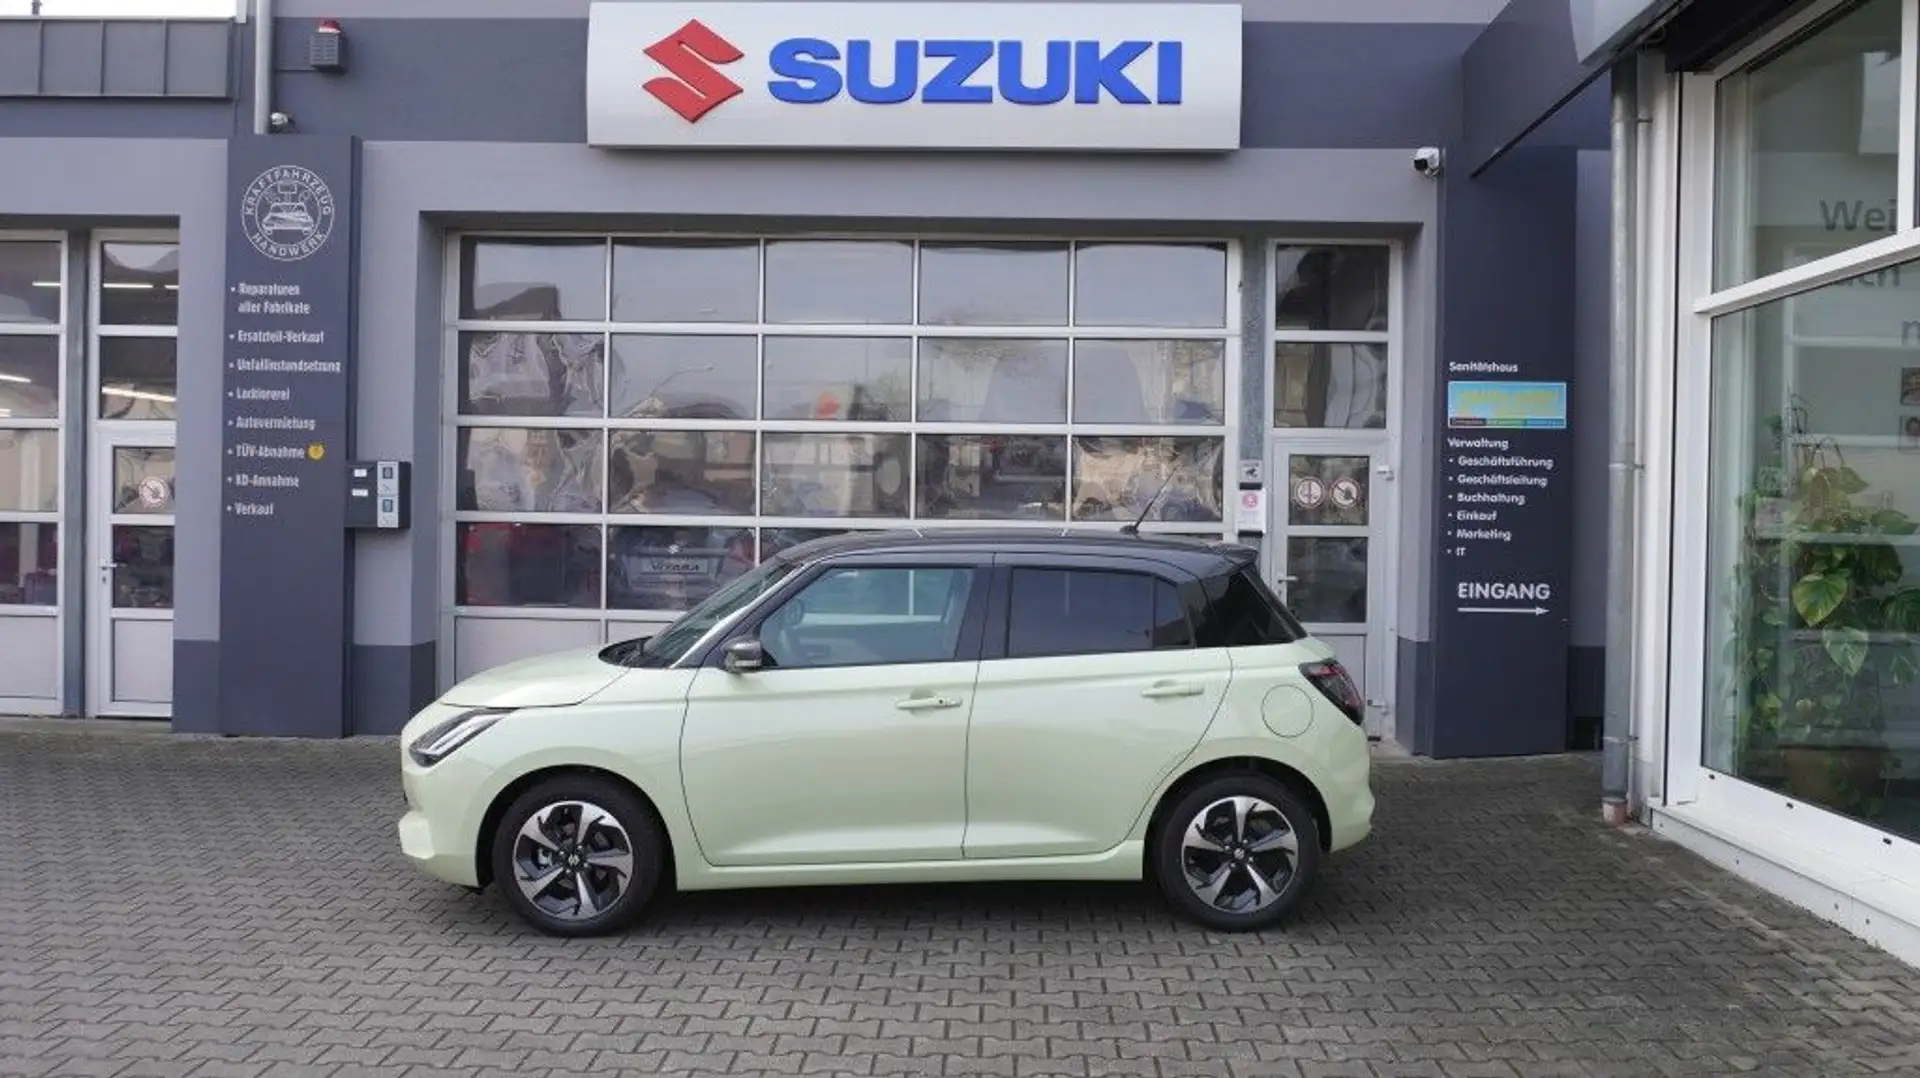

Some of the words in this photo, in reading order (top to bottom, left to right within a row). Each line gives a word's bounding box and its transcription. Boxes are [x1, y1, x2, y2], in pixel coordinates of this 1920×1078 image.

[767, 37, 1184, 106] SUZUKI
[245, 168, 333, 217] KRAFTFAHRZEUG
[251, 231, 326, 257] HANDWERK
[238, 282, 300, 296] Reparaturen
[238, 302, 260, 313] aller
[264, 301, 311, 314] Fabrikate
[238, 330, 324, 343] Ersatzteil-Verkauf
[237, 359, 341, 373] Unfallinstandsetzung
[1449, 361, 1518, 373] Sanitätshaus
[236, 387, 290, 400] Lackiererei
[236, 416, 316, 430] Autovermietung
[236, 443, 305, 458] TÜV-Abnahme
[1448, 438, 1509, 450] Verwaltung
[1458, 456, 1554, 469] Geschäftsführung
[235, 474, 299, 487] KD-Annahme
[1457, 474, 1548, 487] Geschäftsleitung
[1457, 492, 1526, 506] Buchhaltung
[235, 502, 274, 515] Verkauf
[1456, 510, 1498, 521] Einkauf
[1456, 528, 1512, 542] Marketing
[1456, 547, 1467, 557] IT
[1457, 581, 1551, 600] EINGANG
